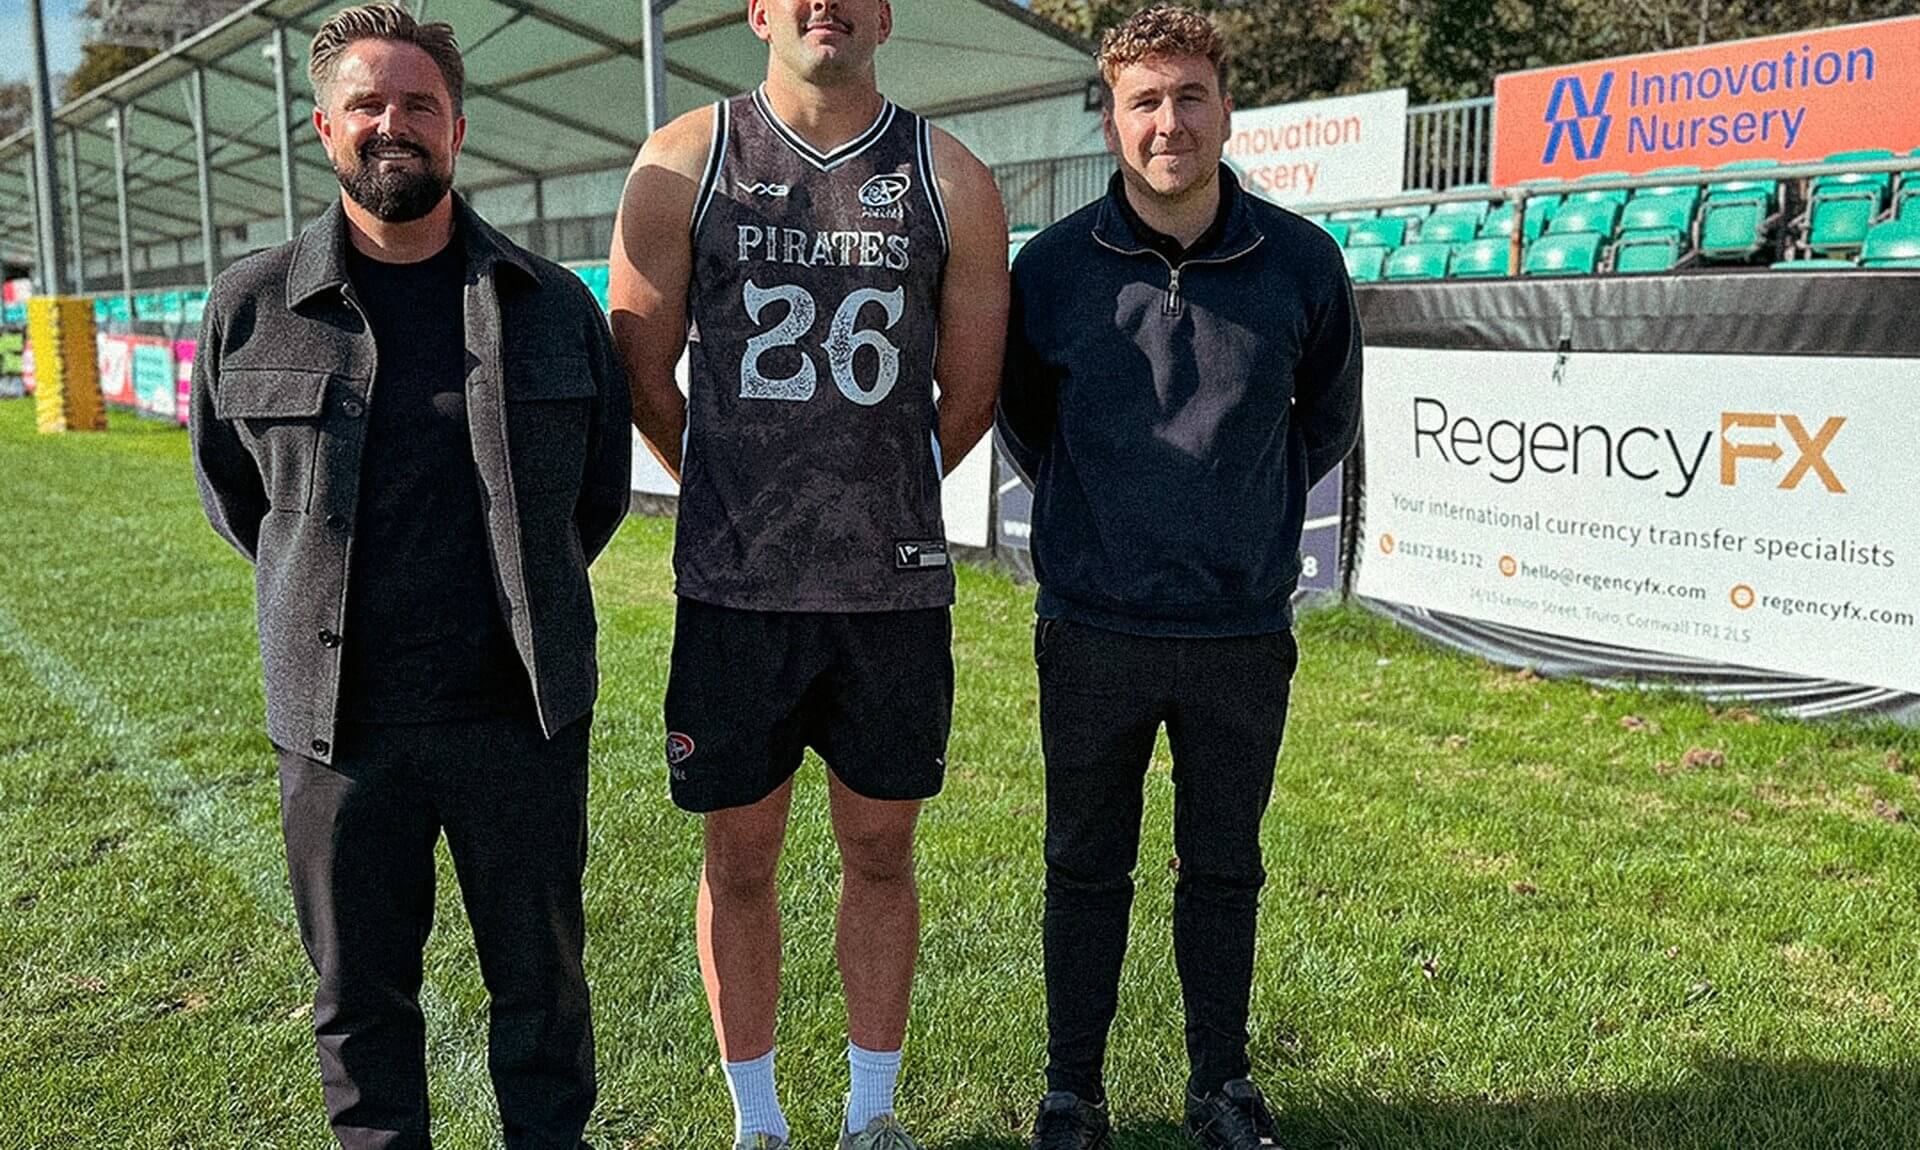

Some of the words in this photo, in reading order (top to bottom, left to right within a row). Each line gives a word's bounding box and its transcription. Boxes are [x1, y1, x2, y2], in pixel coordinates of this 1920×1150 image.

[1628, 44, 1875, 107] Innovation
[1627, 106, 1806, 153] Nursery
[737, 224, 910, 271] PIRATES
[739, 278, 904, 406] 26
[1413, 397, 1847, 499] RegencyFX
[1391, 492, 1424, 514] Your
[1429, 500, 1540, 532] international
[1545, 517, 1641, 548] currency
[1650, 526, 1748, 553] transfer
[1754, 536, 1896, 568] specialists
[1521, 560, 1707, 600] hello@regencyfx.com
[1626, 612, 1689, 635] Cornwall
[1762, 593, 1915, 627] regencyfx.com
